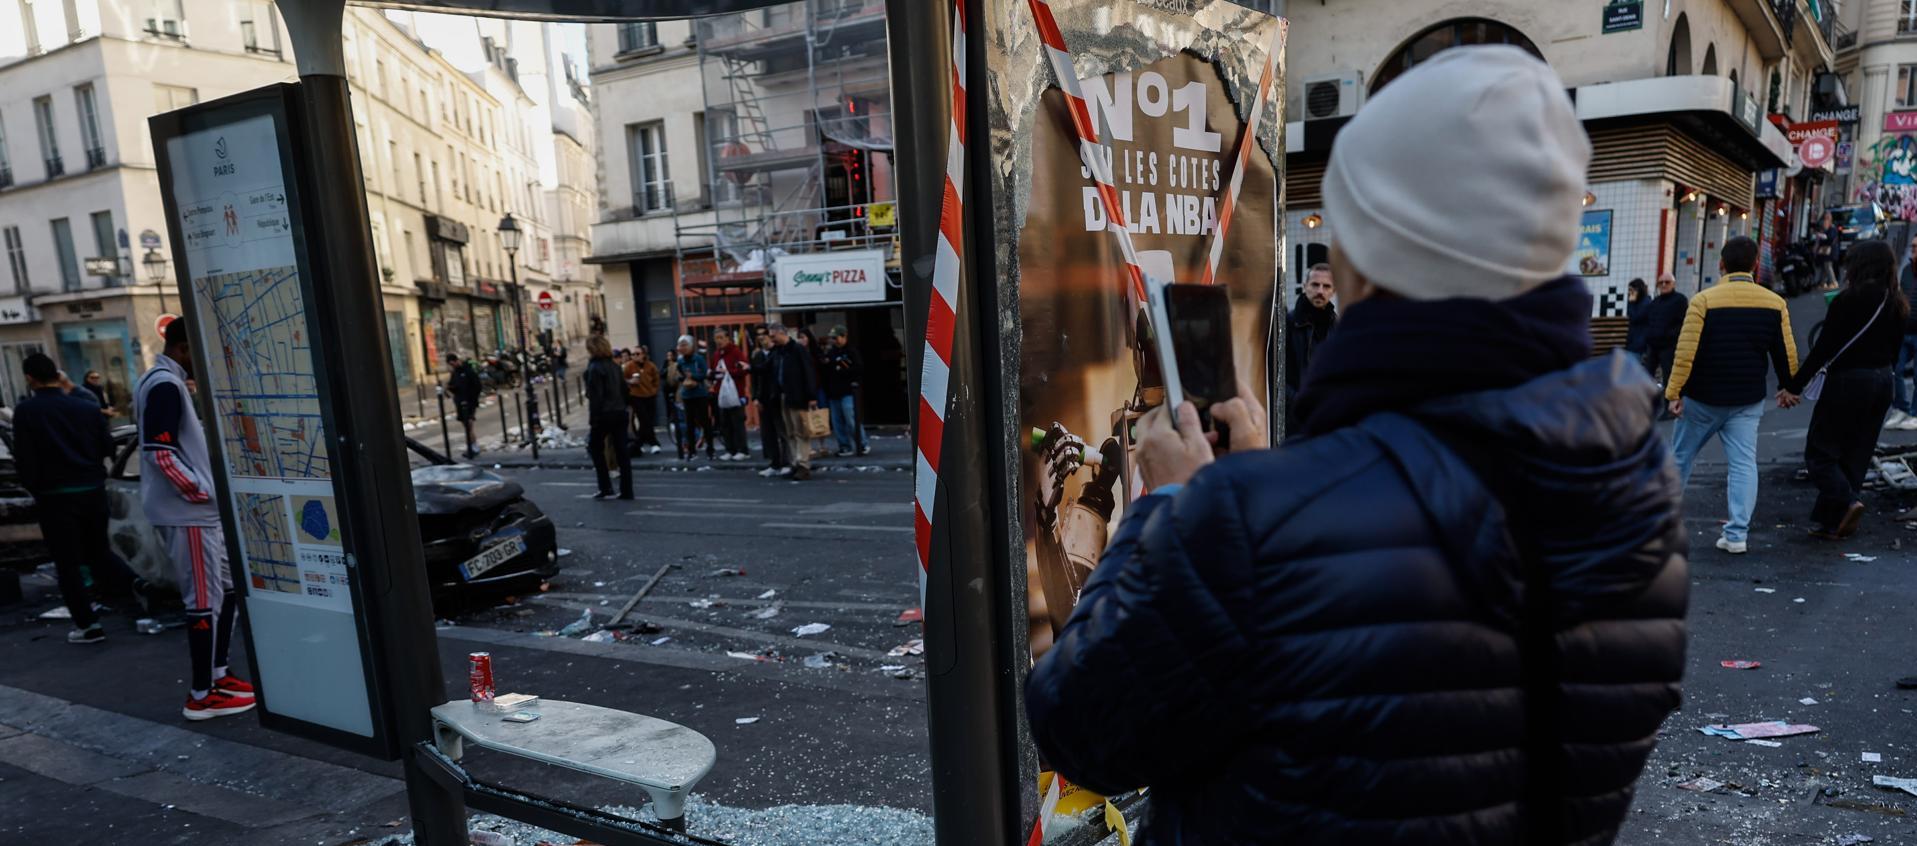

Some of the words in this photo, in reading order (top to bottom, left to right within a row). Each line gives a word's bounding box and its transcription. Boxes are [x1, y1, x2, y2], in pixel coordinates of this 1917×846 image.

[1813, 108, 1858, 122] CHANGE
[1788, 127, 1836, 141] CHANGE
[213, 163, 235, 177] PARIS
[1124, 149, 1158, 186] LES
[1169, 154, 1220, 191] COTES
[1122, 190, 1160, 234] LA
[1166, 193, 1218, 235] NBA
[793, 270, 831, 287] Sonny's
[832, 269, 866, 283] PIZZA
